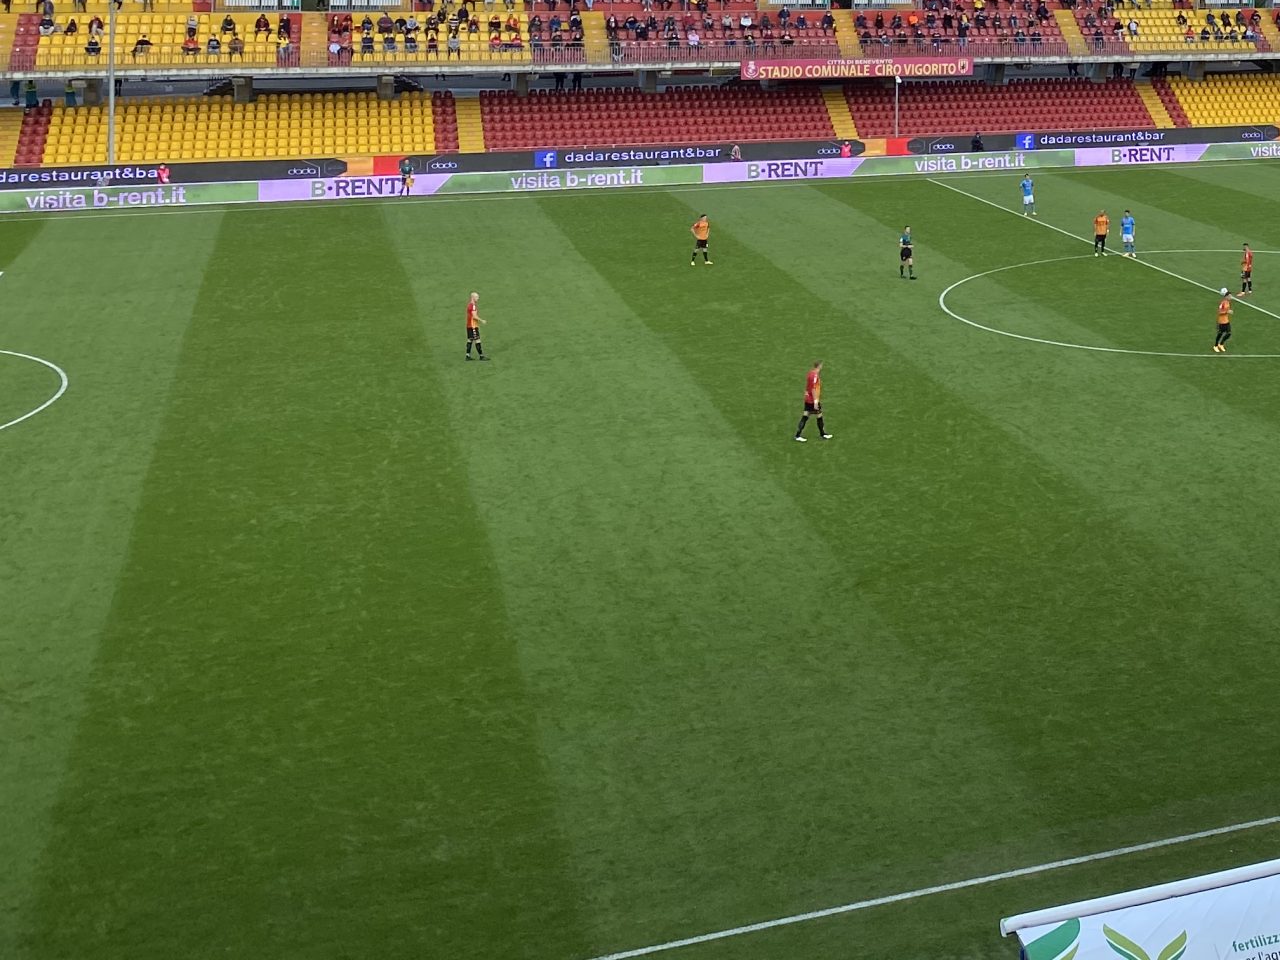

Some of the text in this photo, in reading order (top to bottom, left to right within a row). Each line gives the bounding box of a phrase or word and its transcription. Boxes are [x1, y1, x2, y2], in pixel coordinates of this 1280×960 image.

[759, 62, 957, 79] STADIO COMUNALE CIRO VIGORITO
[1040, 132, 1165, 146] dadarestaurant&bar
[564, 148, 721, 163] dadarestaurant&bar
[915, 153, 1025, 171] visita b-rent.it
[0, 167, 158, 183] darestaurant&ba
[511, 169, 643, 189] visita b-rent.it
[26, 187, 187, 210] visita b-rent.it
